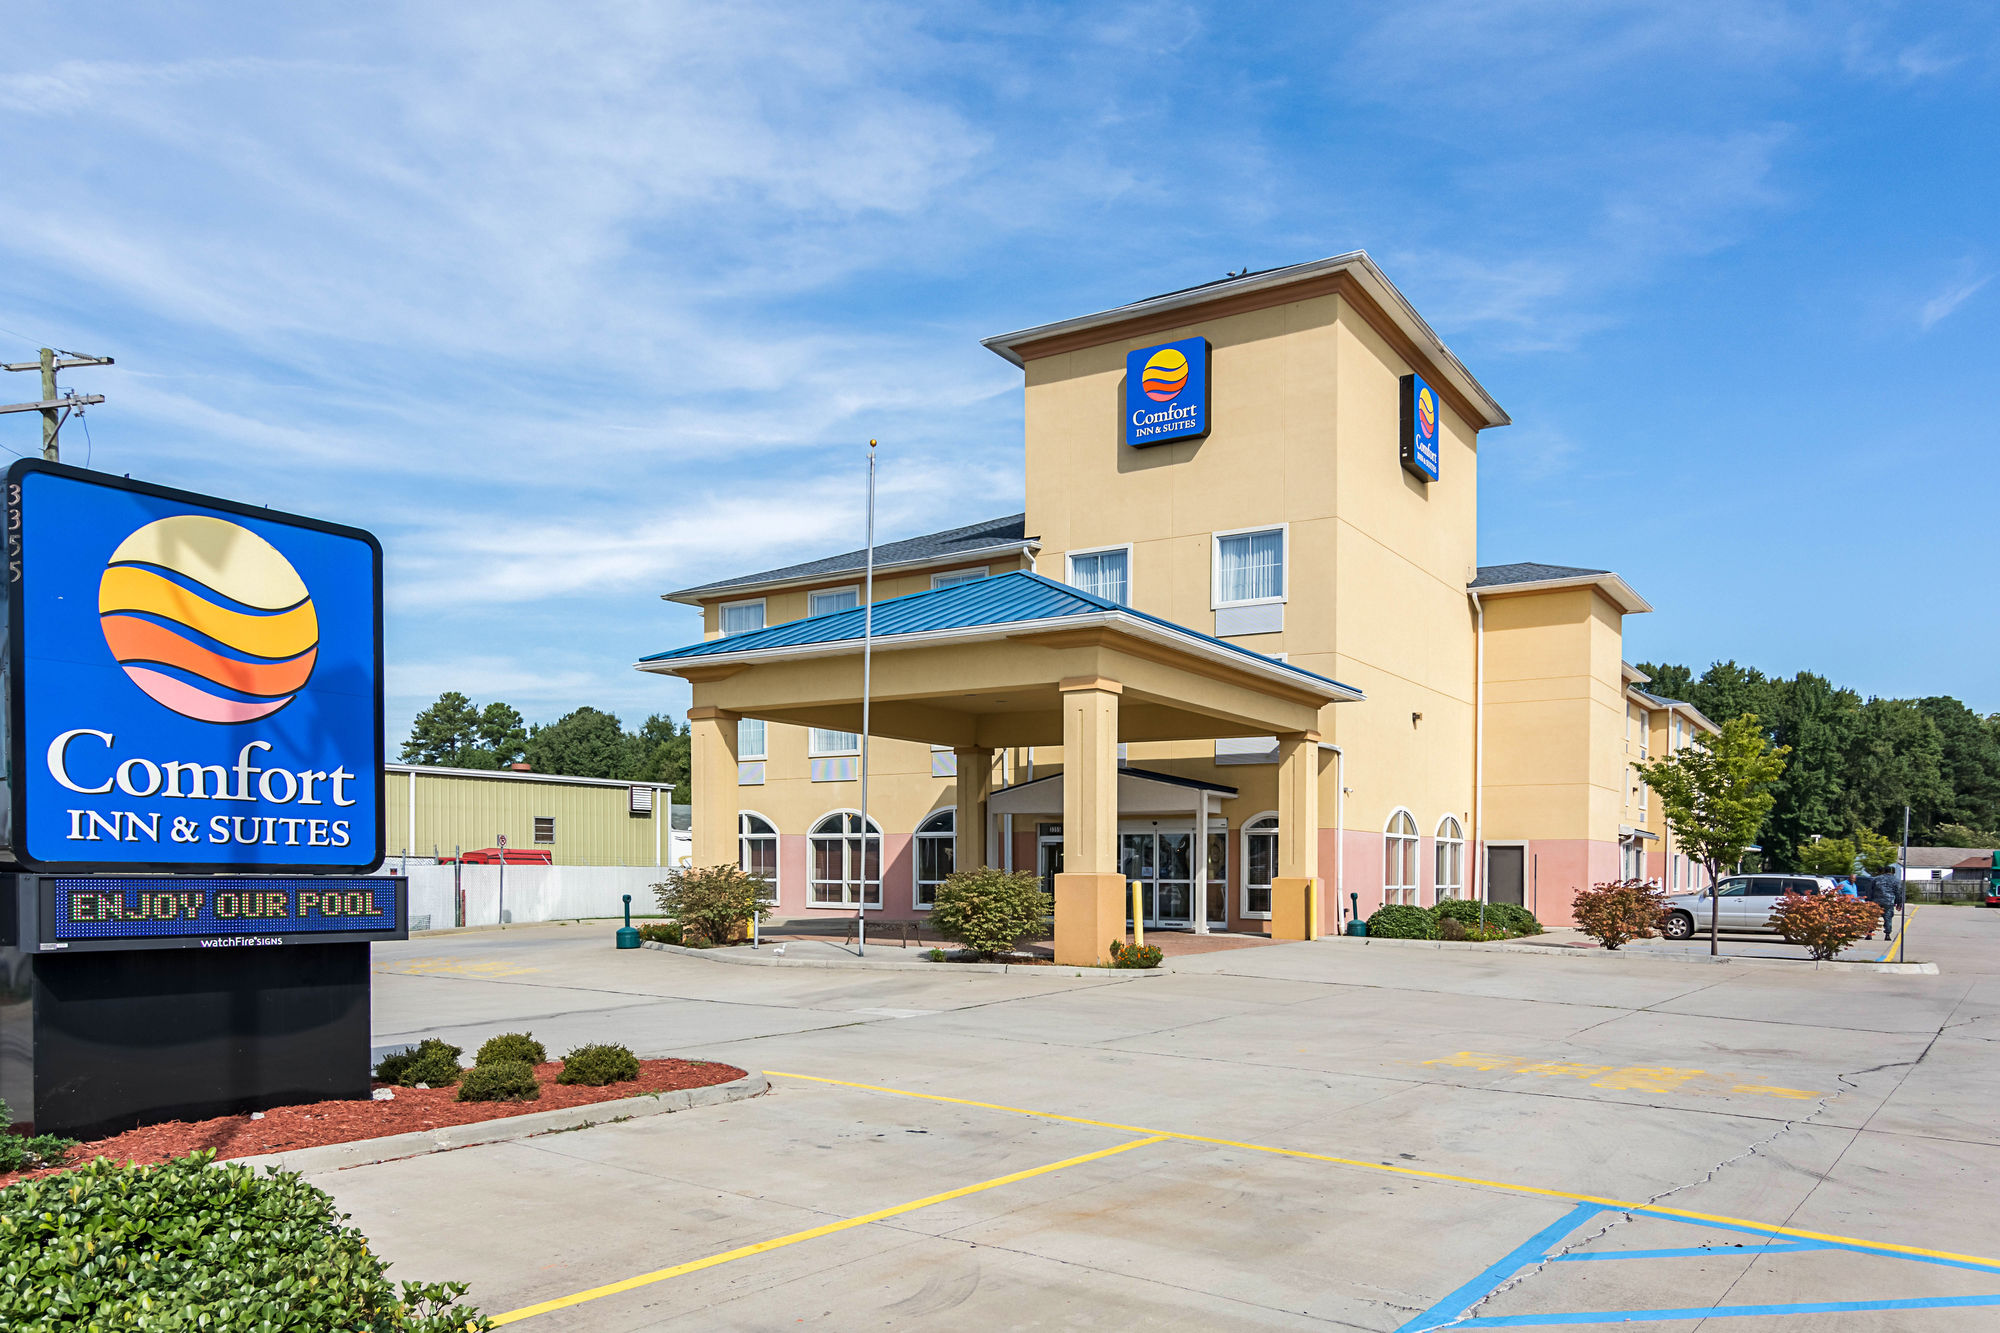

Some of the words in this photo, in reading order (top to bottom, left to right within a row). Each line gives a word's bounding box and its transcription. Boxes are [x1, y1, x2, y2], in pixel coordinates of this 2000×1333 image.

[1132, 402, 1197, 426] Comfort
[1136, 426, 1154, 437] INN
[1155, 426, 1162, 434] &
[1163, 419, 1196, 433] SUITES
[8, 484, 21, 582] 3355
[47, 728, 357, 807] Comfort
[66, 809, 162, 843] INN
[170, 816, 200, 843] &
[208, 815, 352, 847] SUITES
[72, 893, 203, 920] ENJOY
[217, 893, 288, 918] OUR
[299, 892, 382, 916] POOL
[256, 937, 283, 945] SIGNS
